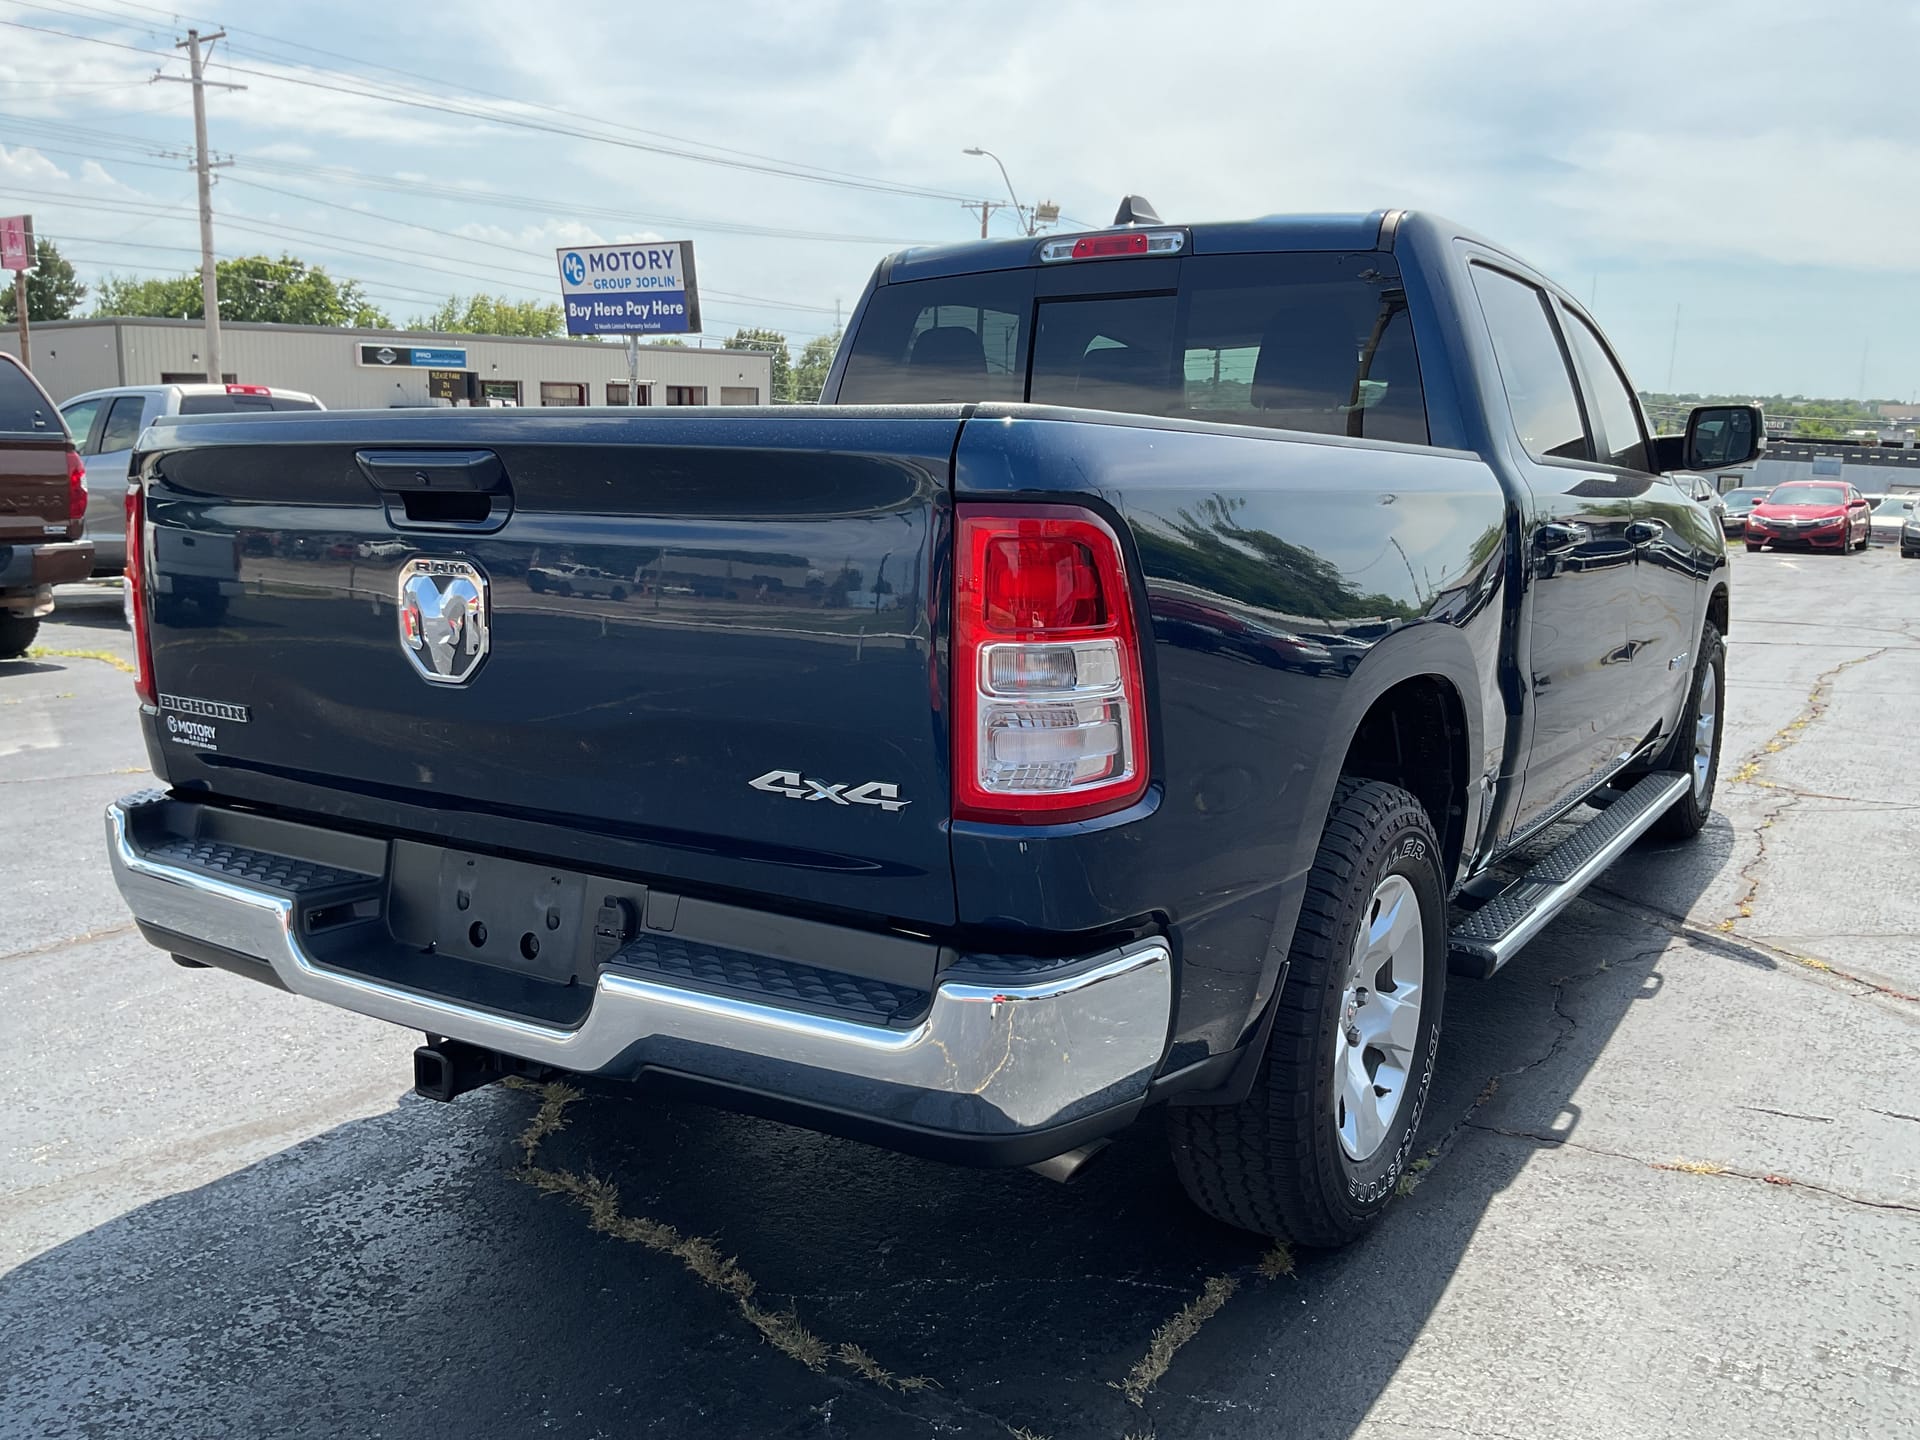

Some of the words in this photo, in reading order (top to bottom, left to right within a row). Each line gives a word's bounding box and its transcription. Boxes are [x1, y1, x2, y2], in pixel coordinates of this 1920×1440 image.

[589, 249, 674, 273] MOTORY
[593, 278, 632, 290] GROUP
[636, 276, 675, 289] JOPLIN
[569, 302, 592, 321] Buy
[594, 301, 623, 317] Here
[626, 300, 650, 320] Pay
[652, 300, 684, 316] Here
[414, 561, 470, 575] RAM
[160, 693, 248, 723] BIGHORN
[177, 719, 216, 739] MOTORY
